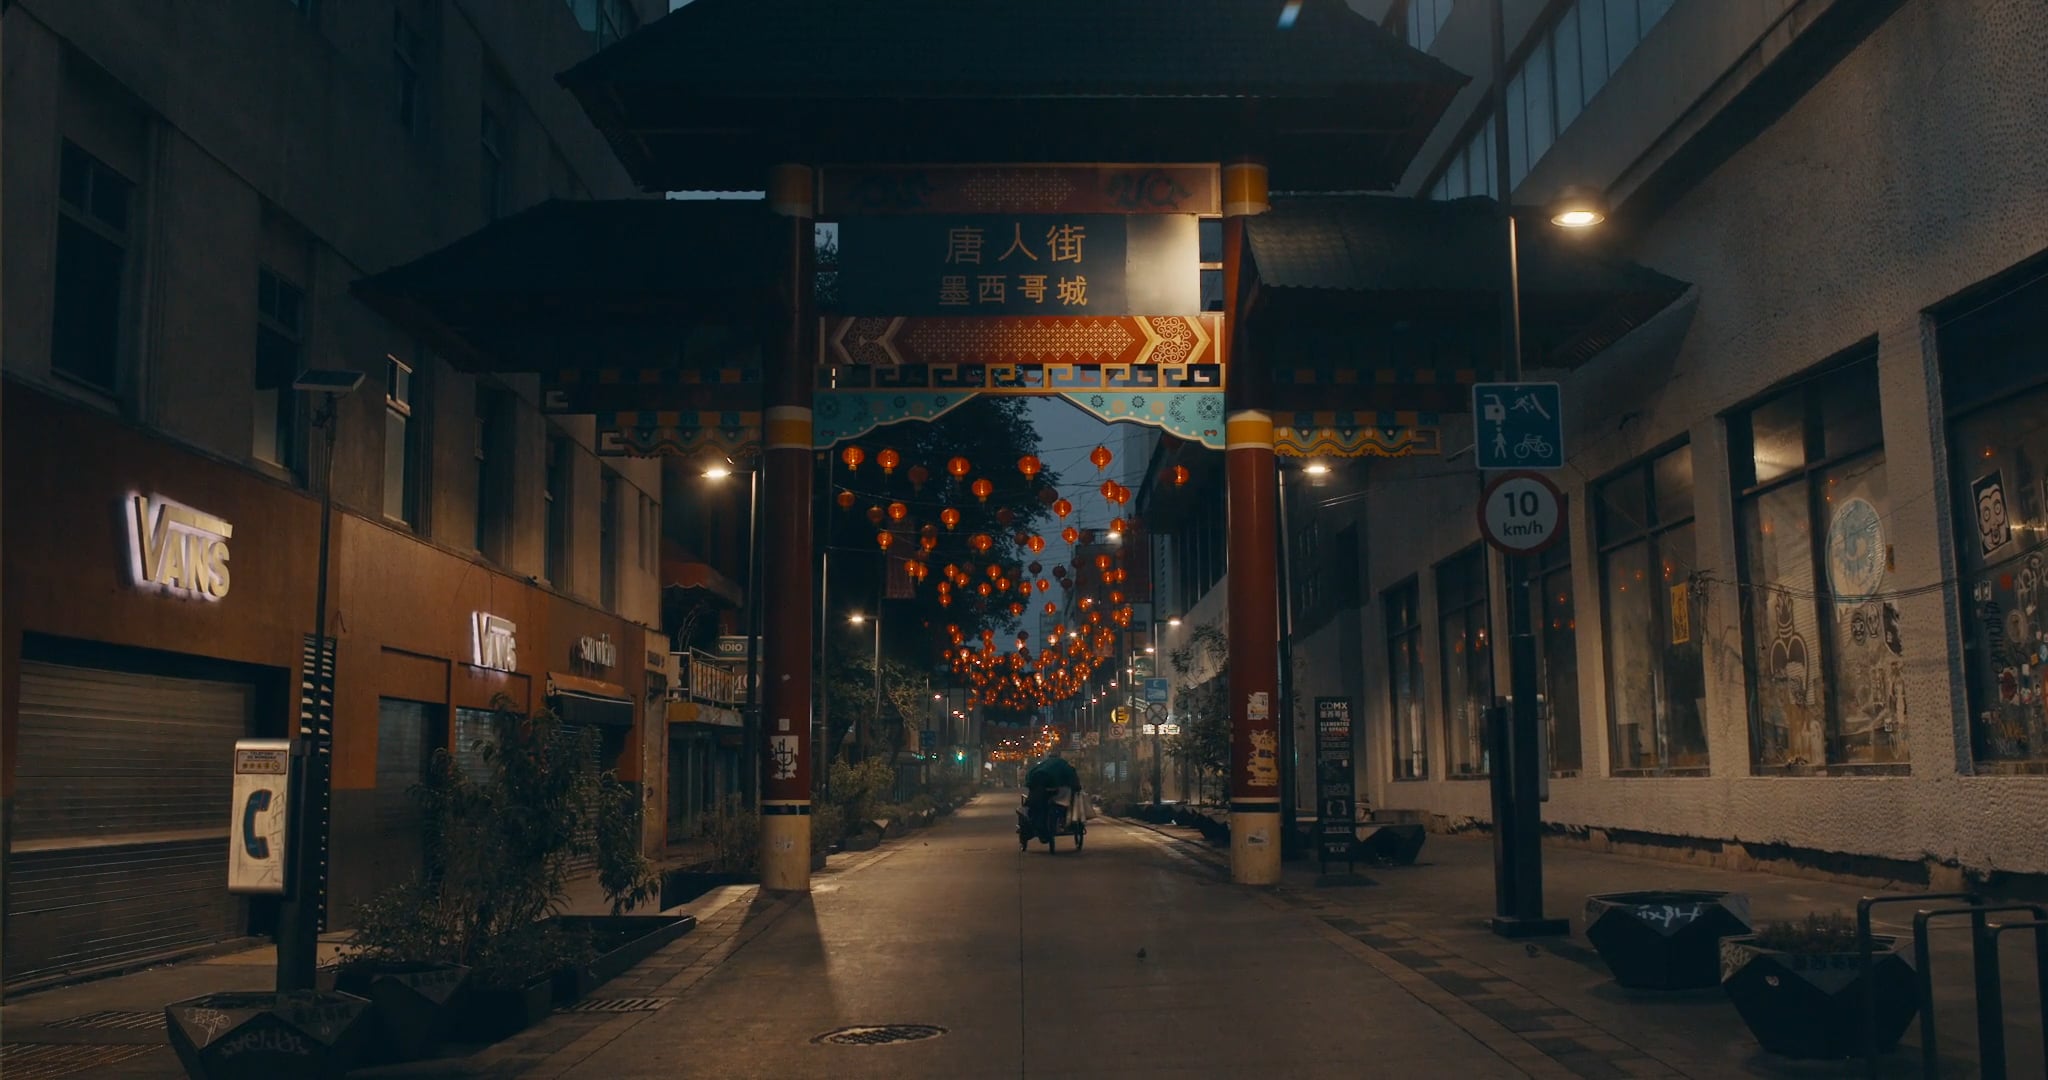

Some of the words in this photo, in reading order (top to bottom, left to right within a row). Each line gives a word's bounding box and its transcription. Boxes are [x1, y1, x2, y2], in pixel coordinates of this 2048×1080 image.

[944, 222, 1087, 264] 唐人街
[938, 274, 1088, 306] 墨西哥城
[1504, 491, 1539, 517] 10
[1503, 520, 1543, 537] km/h
[131, 494, 233, 598] VANS
[474, 612, 517, 672] VANS
[1320, 702, 1348, 710] CDMX
